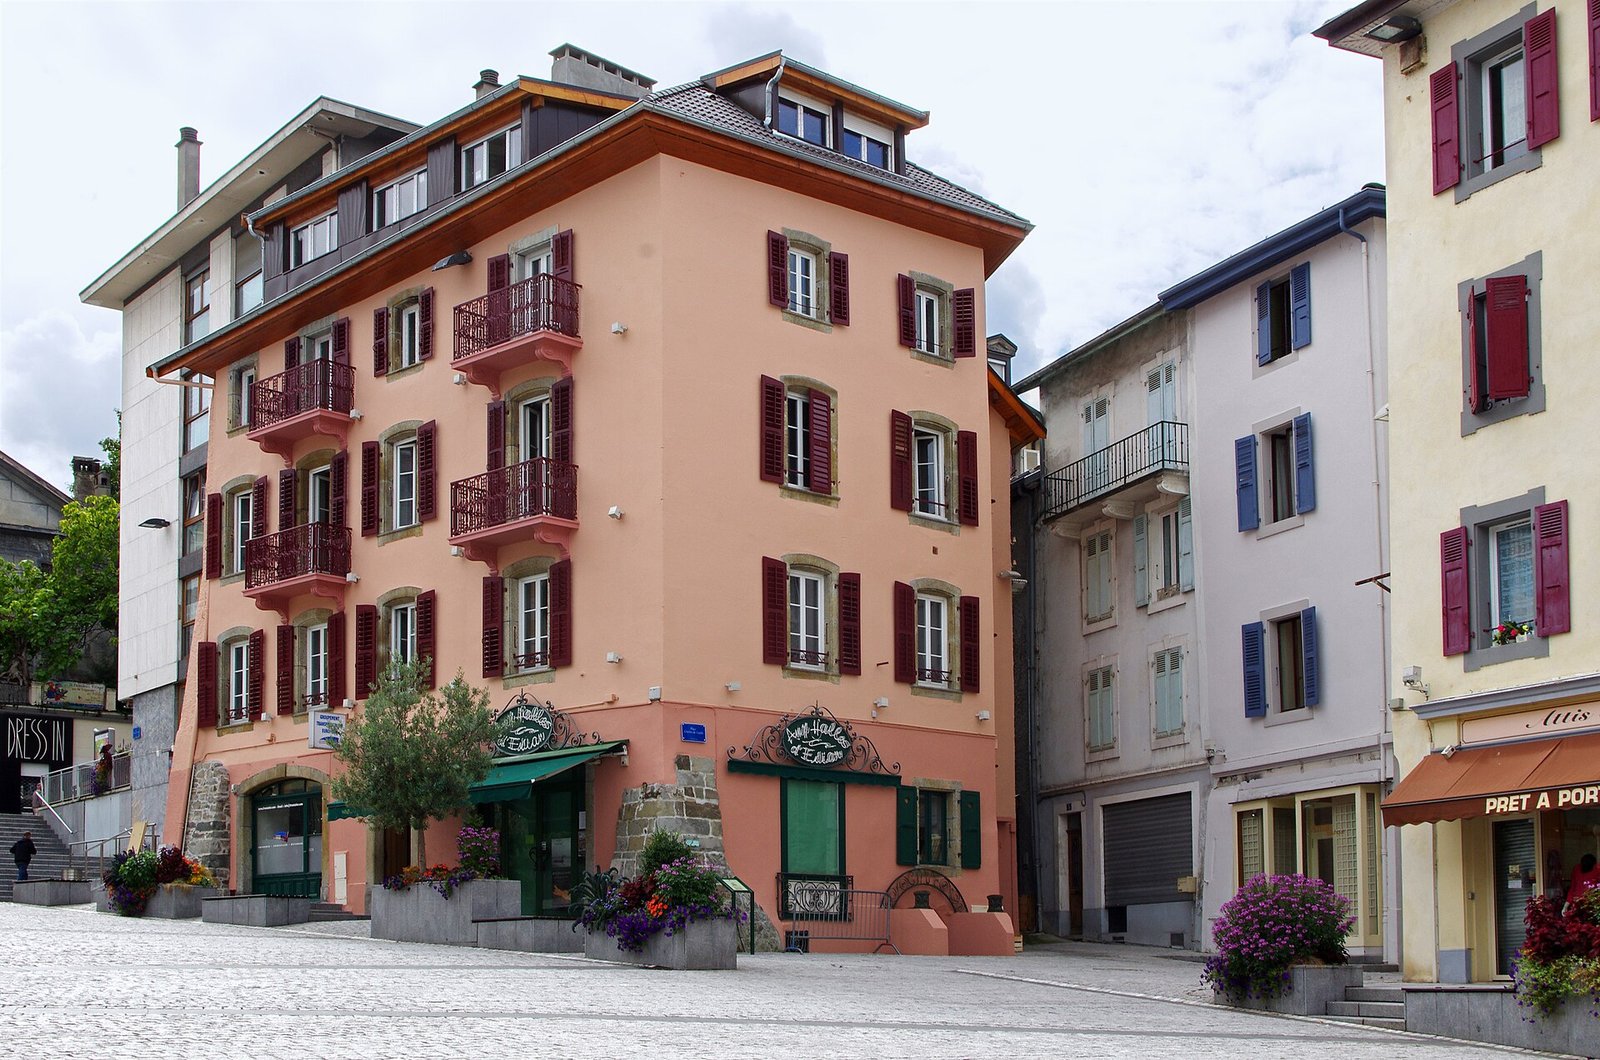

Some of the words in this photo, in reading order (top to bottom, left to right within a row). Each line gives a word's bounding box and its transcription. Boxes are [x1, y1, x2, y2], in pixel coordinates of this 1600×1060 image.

[52, 720, 65, 762] IN
[810, 718, 851, 749] Halles
[1485, 793, 1531, 814] PRET
[1536, 792, 1551, 809] A
[1558, 785, 1600, 807] POR
